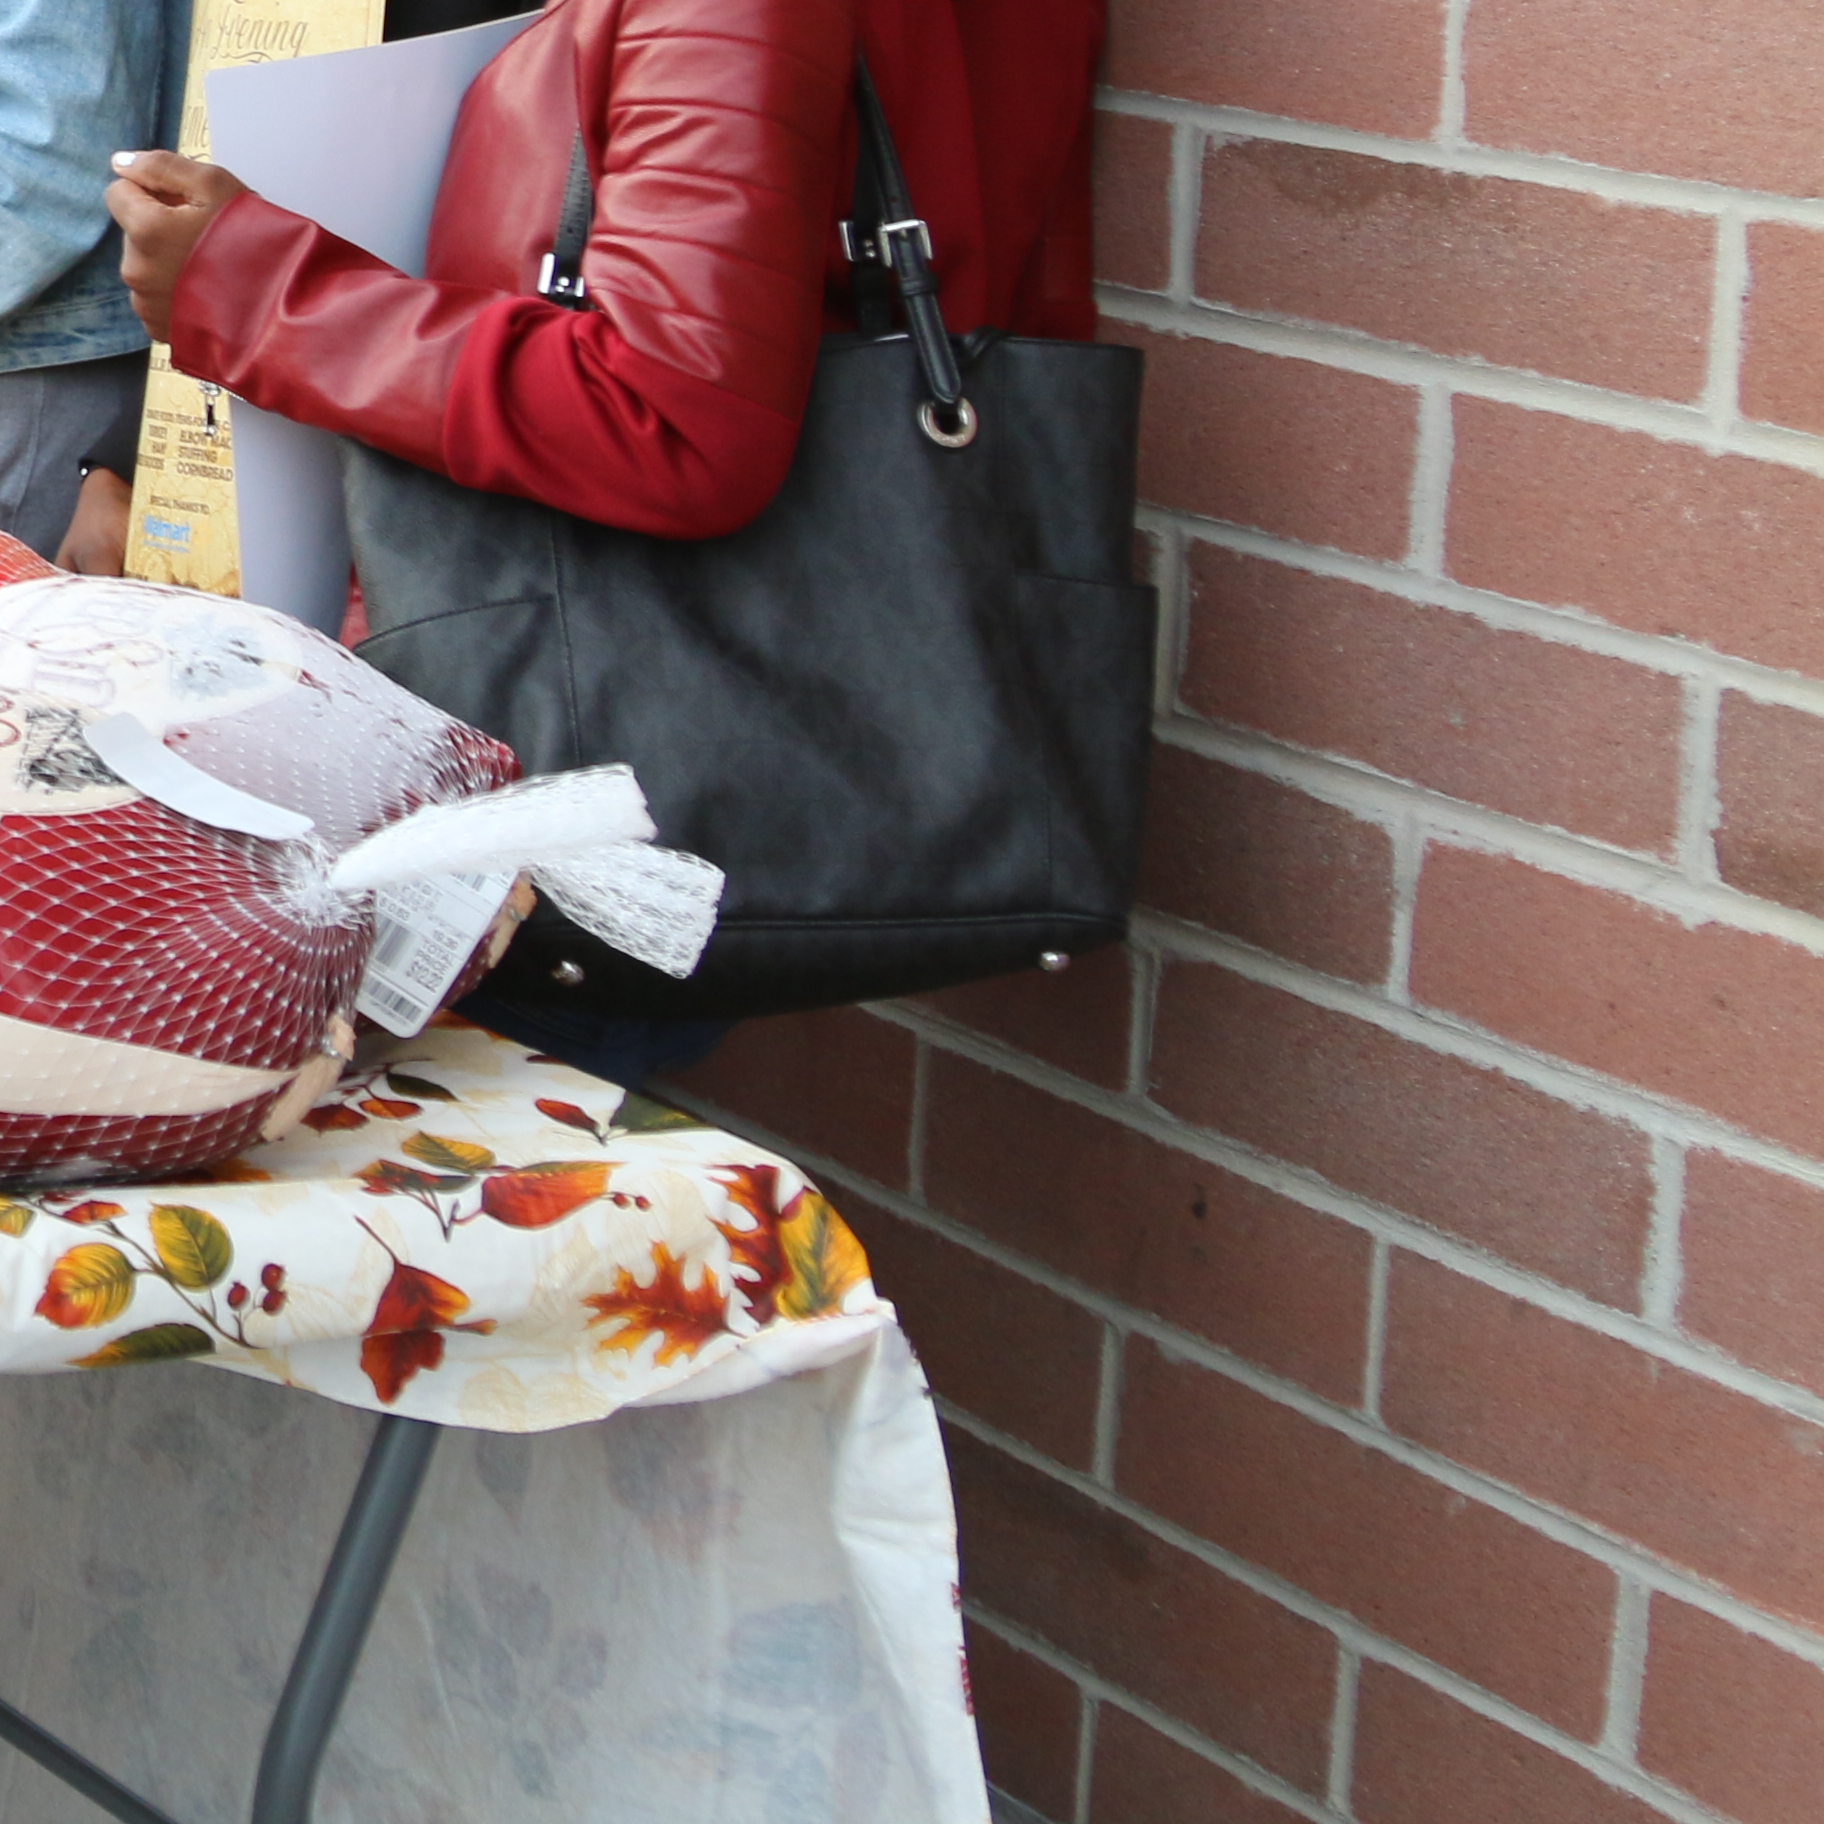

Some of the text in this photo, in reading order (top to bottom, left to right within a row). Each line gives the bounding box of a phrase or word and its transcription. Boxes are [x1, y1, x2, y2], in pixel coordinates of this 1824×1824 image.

[178, 445, 219, 464] STUFFING
[176, 461, 234, 483] CORNBREAD
[416, 949, 449, 975] PRICE
[423, 939, 455, 967] TOTAL
